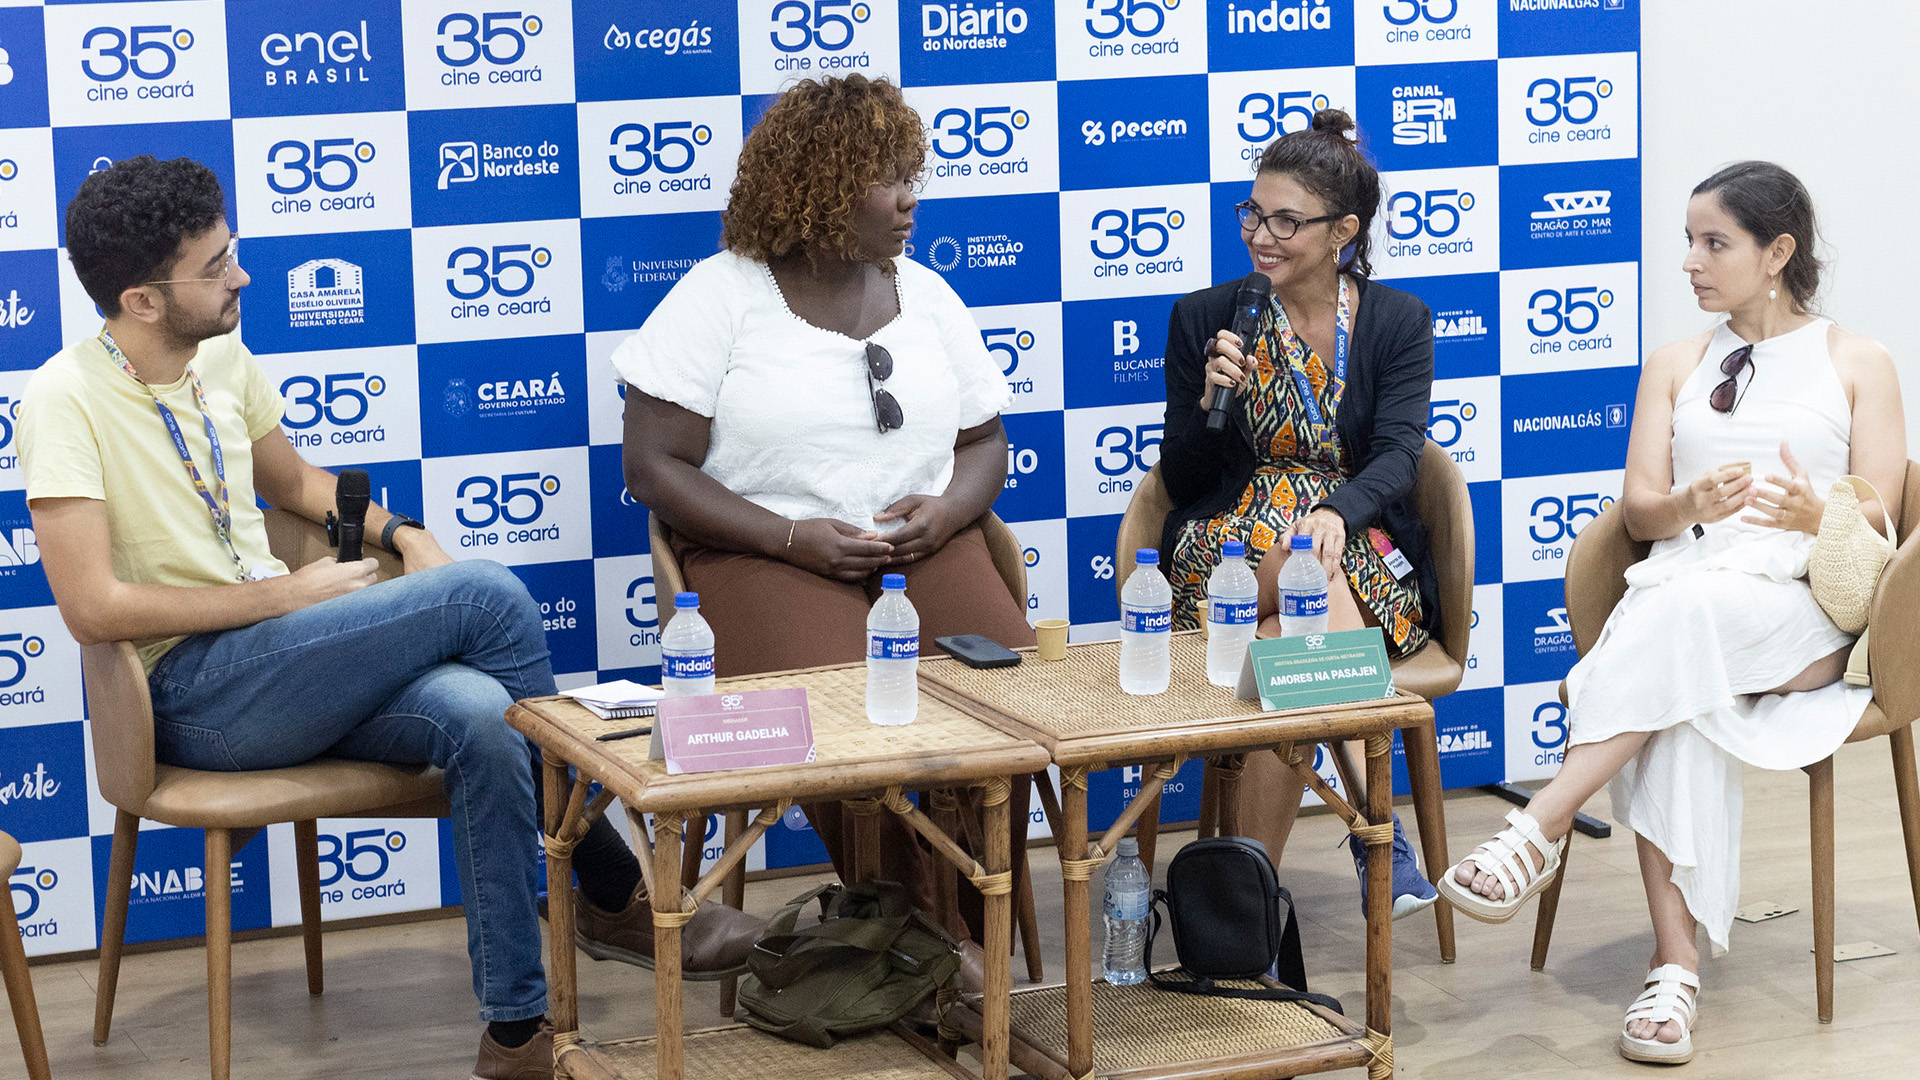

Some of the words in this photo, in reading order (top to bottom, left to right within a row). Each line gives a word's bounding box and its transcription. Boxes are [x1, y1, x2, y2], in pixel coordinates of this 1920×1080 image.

[261, 20, 372, 66] enel
[635, 20, 712, 55] cegás
[923, 38, 941, 51] do
[943, 35, 1007, 50] Nordeste
[1386, 27, 1419, 43] cine
[1426, 24, 1471, 41] ceará
[1089, 41, 1123, 57] cine
[1131, 38, 1179, 54] ceará
[774, 53, 811, 71] cine
[819, 51, 869, 69] ceará
[266, 67, 369, 85] BRASIL
[441, 68, 480, 86] cine
[488, 65, 542, 83] ceará
[87, 84, 128, 101] cine
[137, 80, 194, 99] ceará
[1392, 85, 1443, 98] CANAL
[1529, 128, 1560, 144] cine
[1567, 125, 1611, 142] ceará
[483, 142, 533, 159] Banco
[538, 140, 559, 157] do
[1241, 146, 1267, 161] cin
[483, 158, 560, 177] Nordeste
[936, 160, 971, 178] cine
[979, 157, 1029, 175] ceará
[613, 177, 651, 195] cine
[659, 173, 711, 192] ceará
[271, 196, 311, 214] cine
[319, 192, 375, 211] ceará
[1573, 219, 1588, 229] DO
[1592, 217, 1612, 228] MAR
[968, 235, 1007, 243] INSTITUTO
[1389, 241, 1421, 257] cine
[1428, 237, 1473, 255] ceará
[633, 258, 704, 271] UNIVERSIDA
[1094, 261, 1128, 278] cine
[1135, 256, 1183, 275] ceará
[634, 272, 678, 282] FEDERAL
[290, 291, 315, 299] CASA
[318, 288, 361, 297] AMARELA
[326, 298, 361, 307] OLIVEIRA
[290, 309, 364, 321] UNIVERSIDADE
[451, 302, 489, 319] cine
[497, 296, 551, 316] ceará
[290, 319, 324, 328] FEDERAL
[326, 318, 337, 326] DO
[1433, 316, 1487, 338] RASIL
[1530, 338, 1561, 354] cine
[1568, 334, 1612, 351] ceará
[1114, 371, 1149, 383] FILMES
[1337, 360, 1345, 377] cine
[478, 371, 565, 401] CEARÁ
[1300, 379, 1310, 396] cine
[478, 402, 518, 410] GOVERNO
[534, 397, 566, 406] ESTADO
[1513, 410, 1602, 433] NACIONALGÁS
[330, 425, 385, 445] ceará
[1451, 447, 1475, 463] ará
[1098, 477, 1133, 495] cine
[460, 530, 499, 547] cine
[507, 523, 559, 544] ceará
[1532, 546, 1564, 561] cine
[543, 615, 577, 631] este
[1270, 673, 1312, 686] AMORES
[1315, 670, 1330, 681] NA
[1331, 666, 1377, 680] PASAJEN
[0, 686, 44, 706] eará
[687, 732, 734, 745] ARTHUR
[736, 727, 789, 741] GADELHA
[320, 889, 343, 904] ne
[352, 879, 405, 900] ceará
